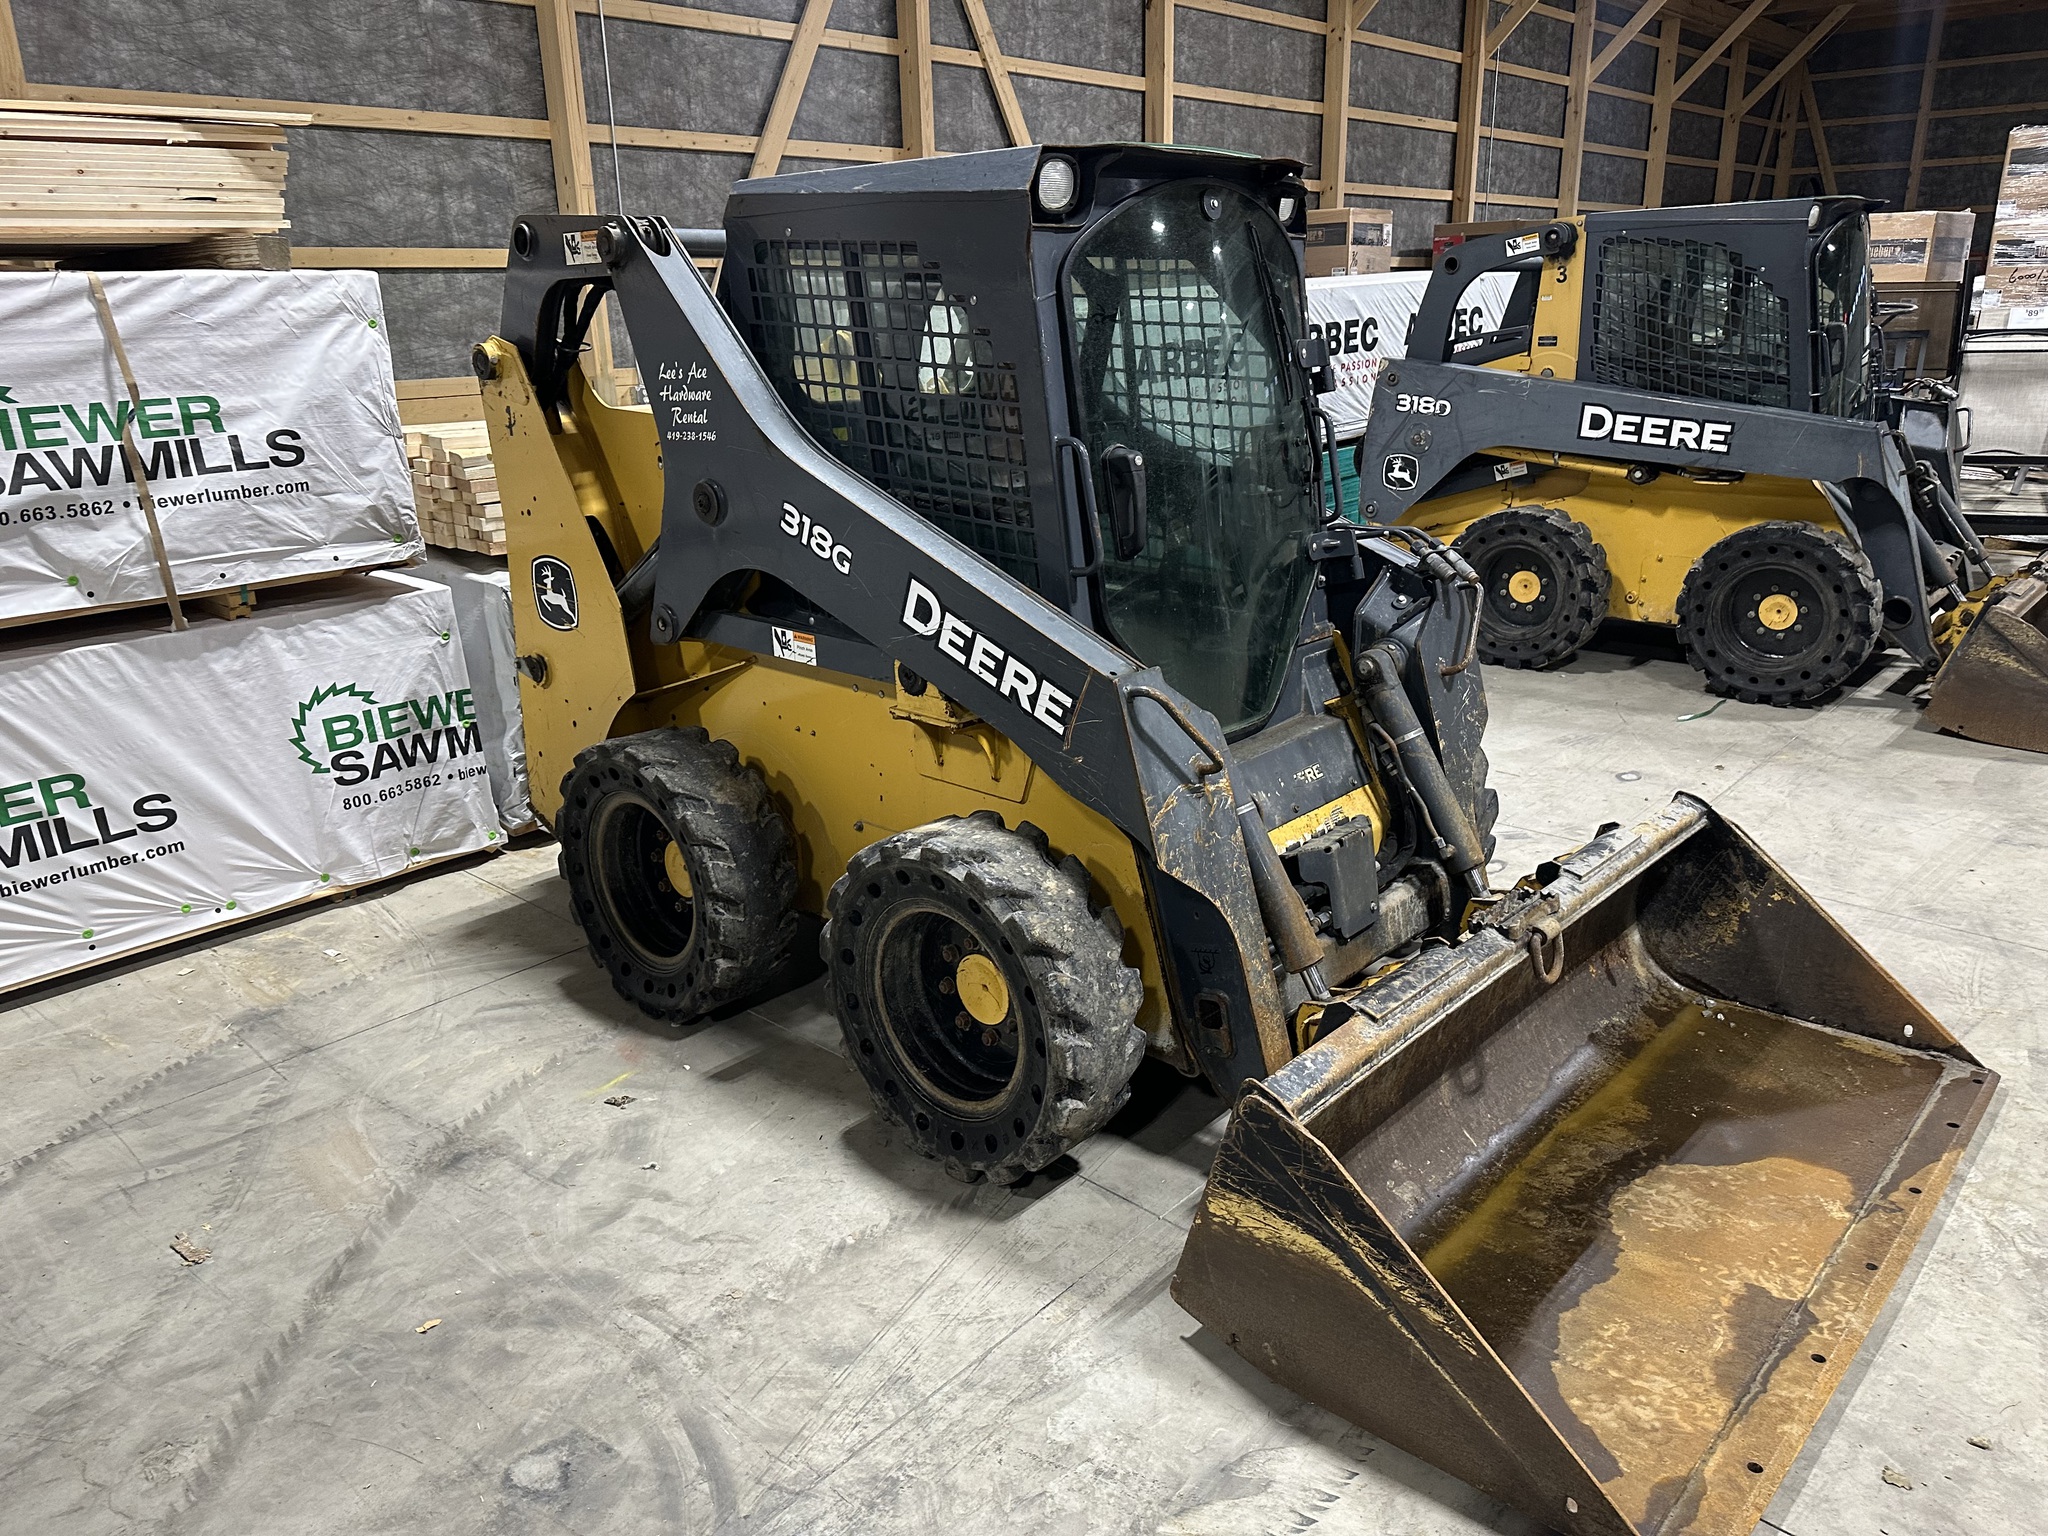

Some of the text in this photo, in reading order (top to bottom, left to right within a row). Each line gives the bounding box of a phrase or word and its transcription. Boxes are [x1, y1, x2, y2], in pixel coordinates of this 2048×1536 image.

[1556, 265, 1568, 284] 3
[658, 361, 708, 384] Lee's Ace
[1340, 358, 1378, 372] PASSION
[659, 384, 712, 402] Hardware
[1396, 393, 1451, 416] 318D
[671, 406, 708, 427] Rental
[666, 430, 717, 441] 419-238-1546
[1579, 404, 1732, 453] DEERE
[0, 429, 305, 496] AWMILLS
[779, 501, 853, 575] 318G
[902, 577, 1073, 736] DEERE
[321, 688, 476, 753] BIEWE
[330, 722, 484, 787] SAWM
[458, 764, 488, 781] biew
[0, 841, 185, 898] biewerlumber.com
